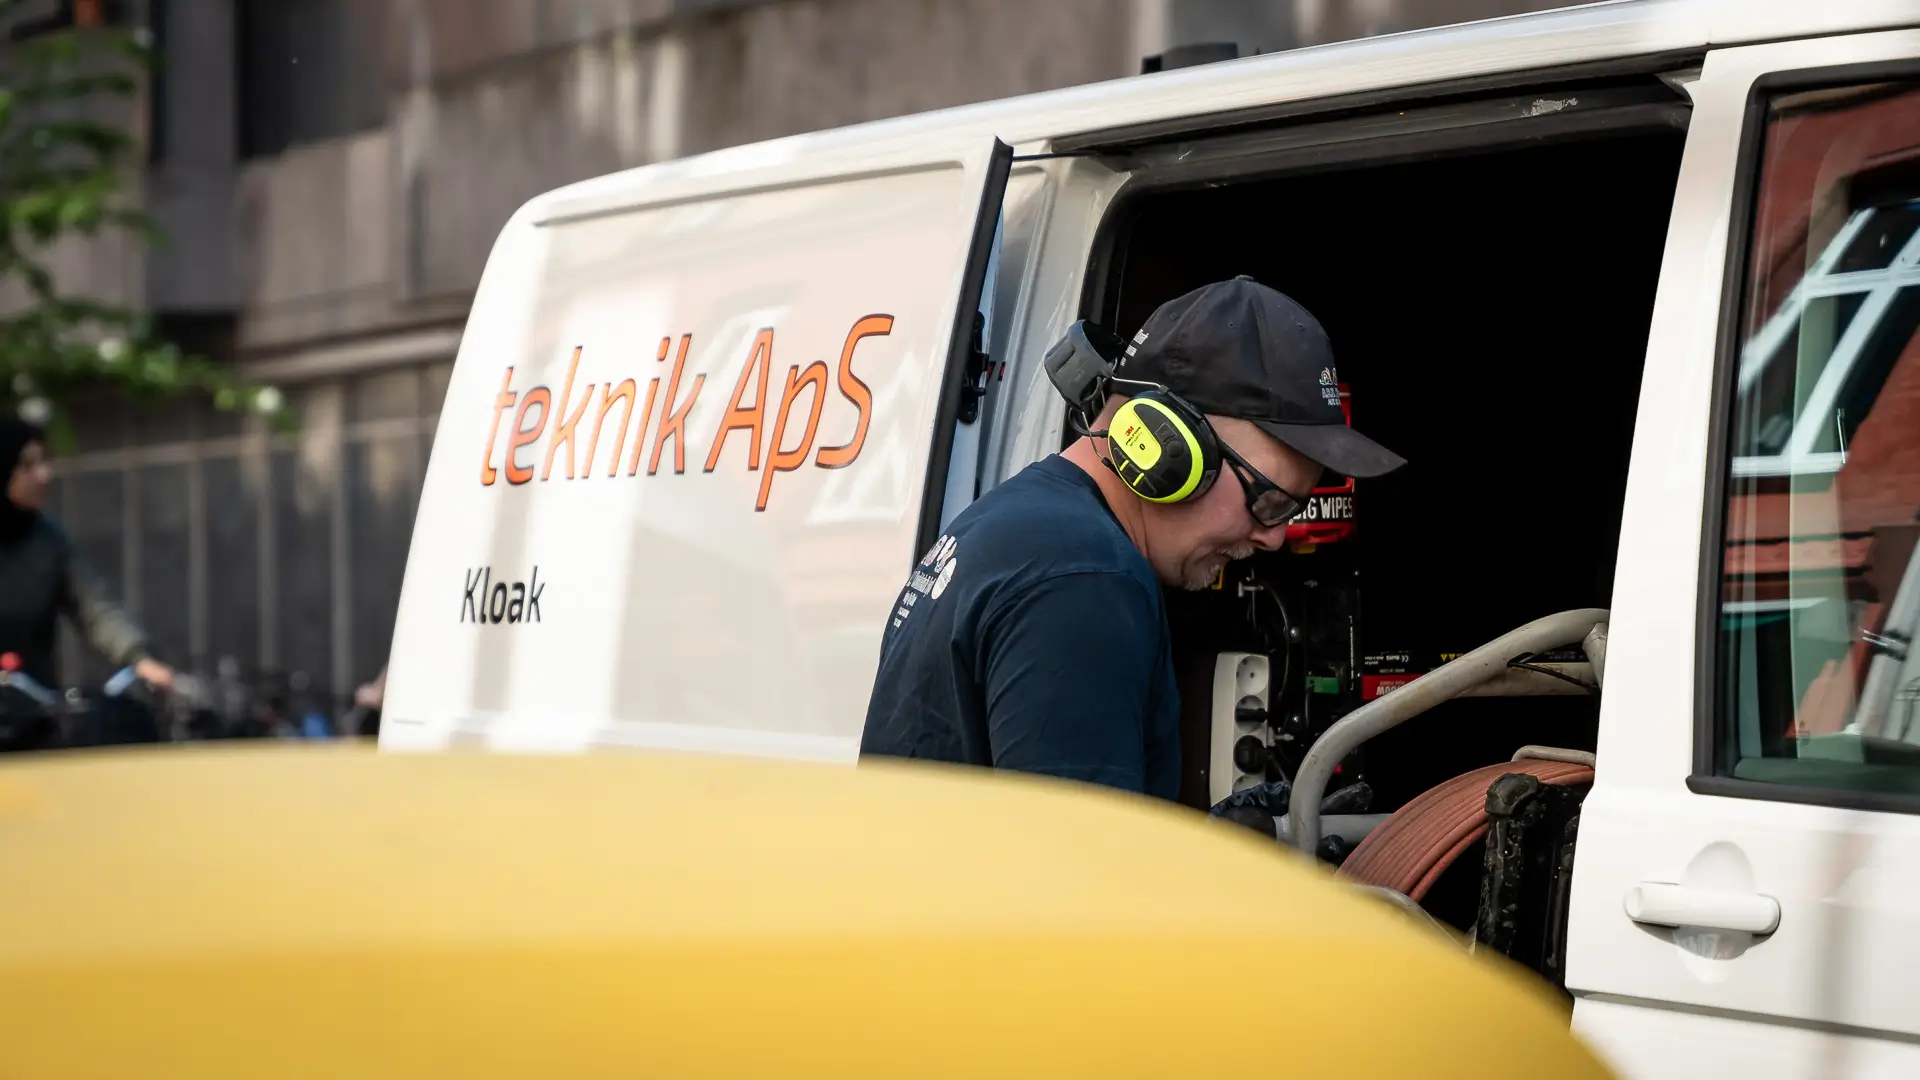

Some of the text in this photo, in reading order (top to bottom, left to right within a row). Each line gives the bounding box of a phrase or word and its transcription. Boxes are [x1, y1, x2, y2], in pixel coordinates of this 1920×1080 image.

[480, 313, 895, 512] teknik ApS
[1319, 496, 1353, 519] WIPES
[459, 565, 546, 625] Kloak
